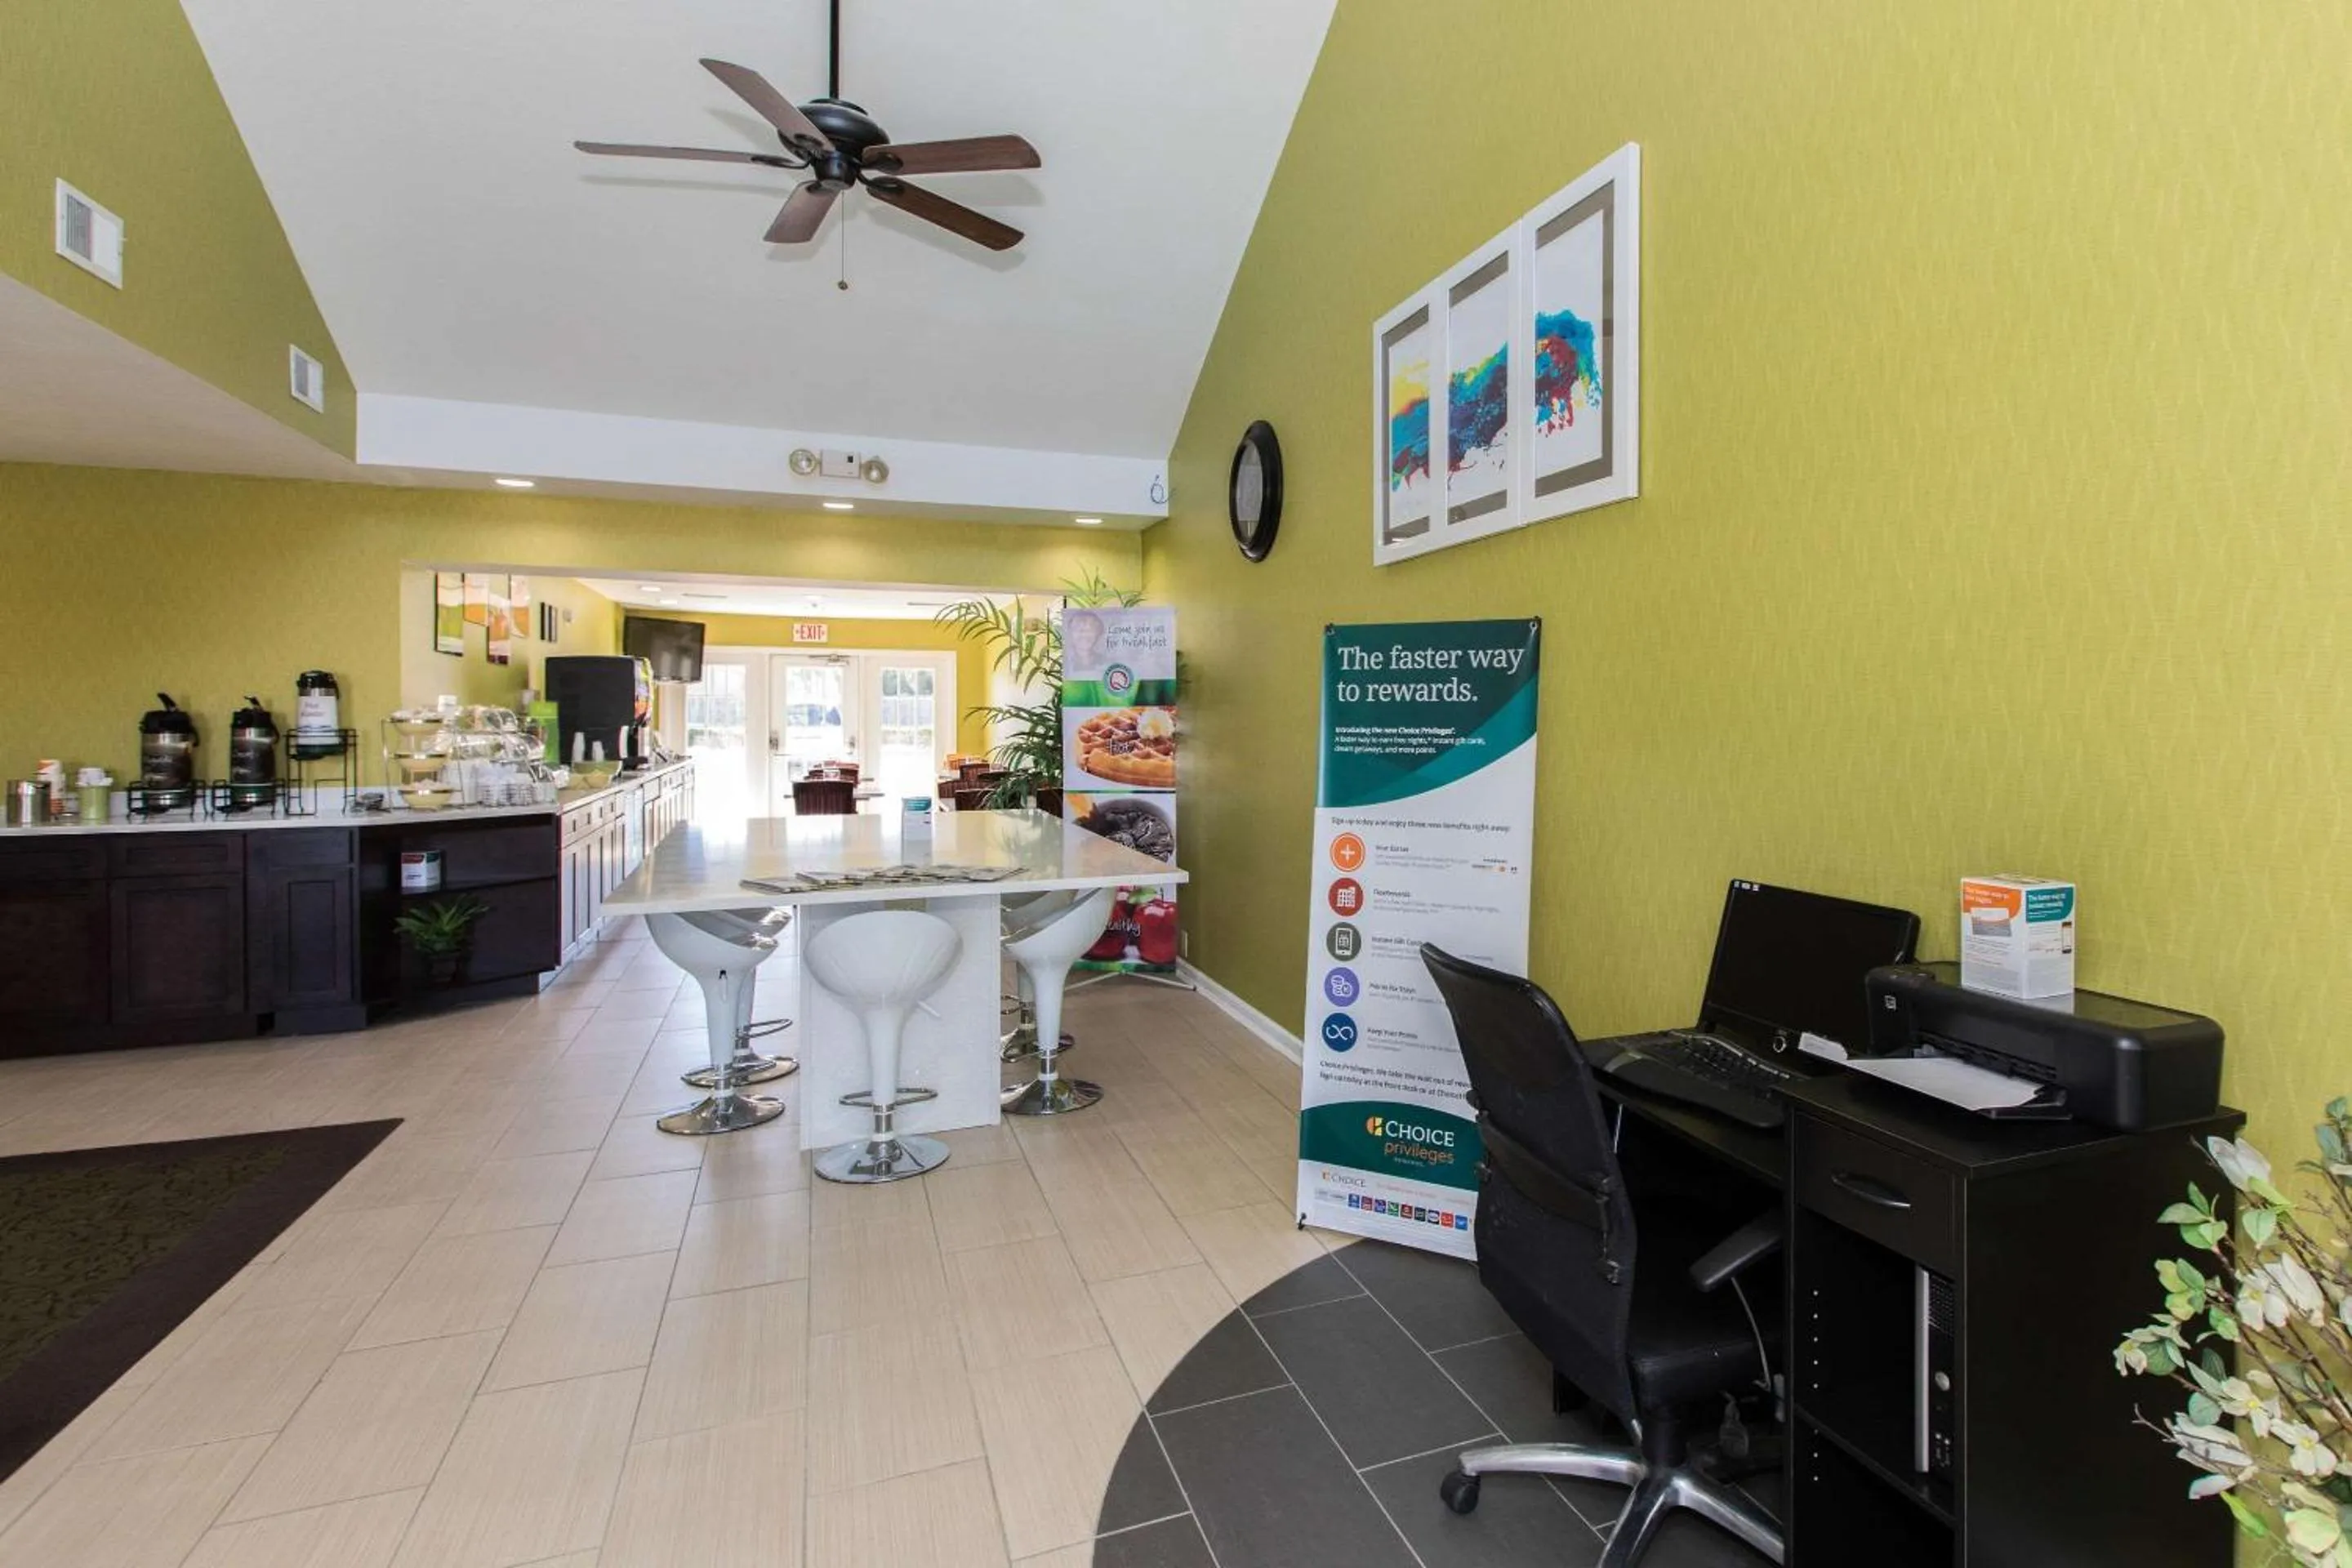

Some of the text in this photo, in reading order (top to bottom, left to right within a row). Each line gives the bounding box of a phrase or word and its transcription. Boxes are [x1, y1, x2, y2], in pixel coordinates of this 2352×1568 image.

[800, 624, 822, 641] EXIT
[1338, 644, 1526, 675] The faster way
[1338, 676, 1478, 702] to rewards.
[1398, 727, 1419, 735] Choice
[1320, 1061, 1341, 1069] Choice
[1405, 1071, 1416, 1080] the
[1372, 1079, 1383, 1087] the
[1385, 1120, 1454, 1147] CHOICE
[1383, 1140, 1455, 1165] privileges
[1330, 1174, 1367, 1187] CHOICE
